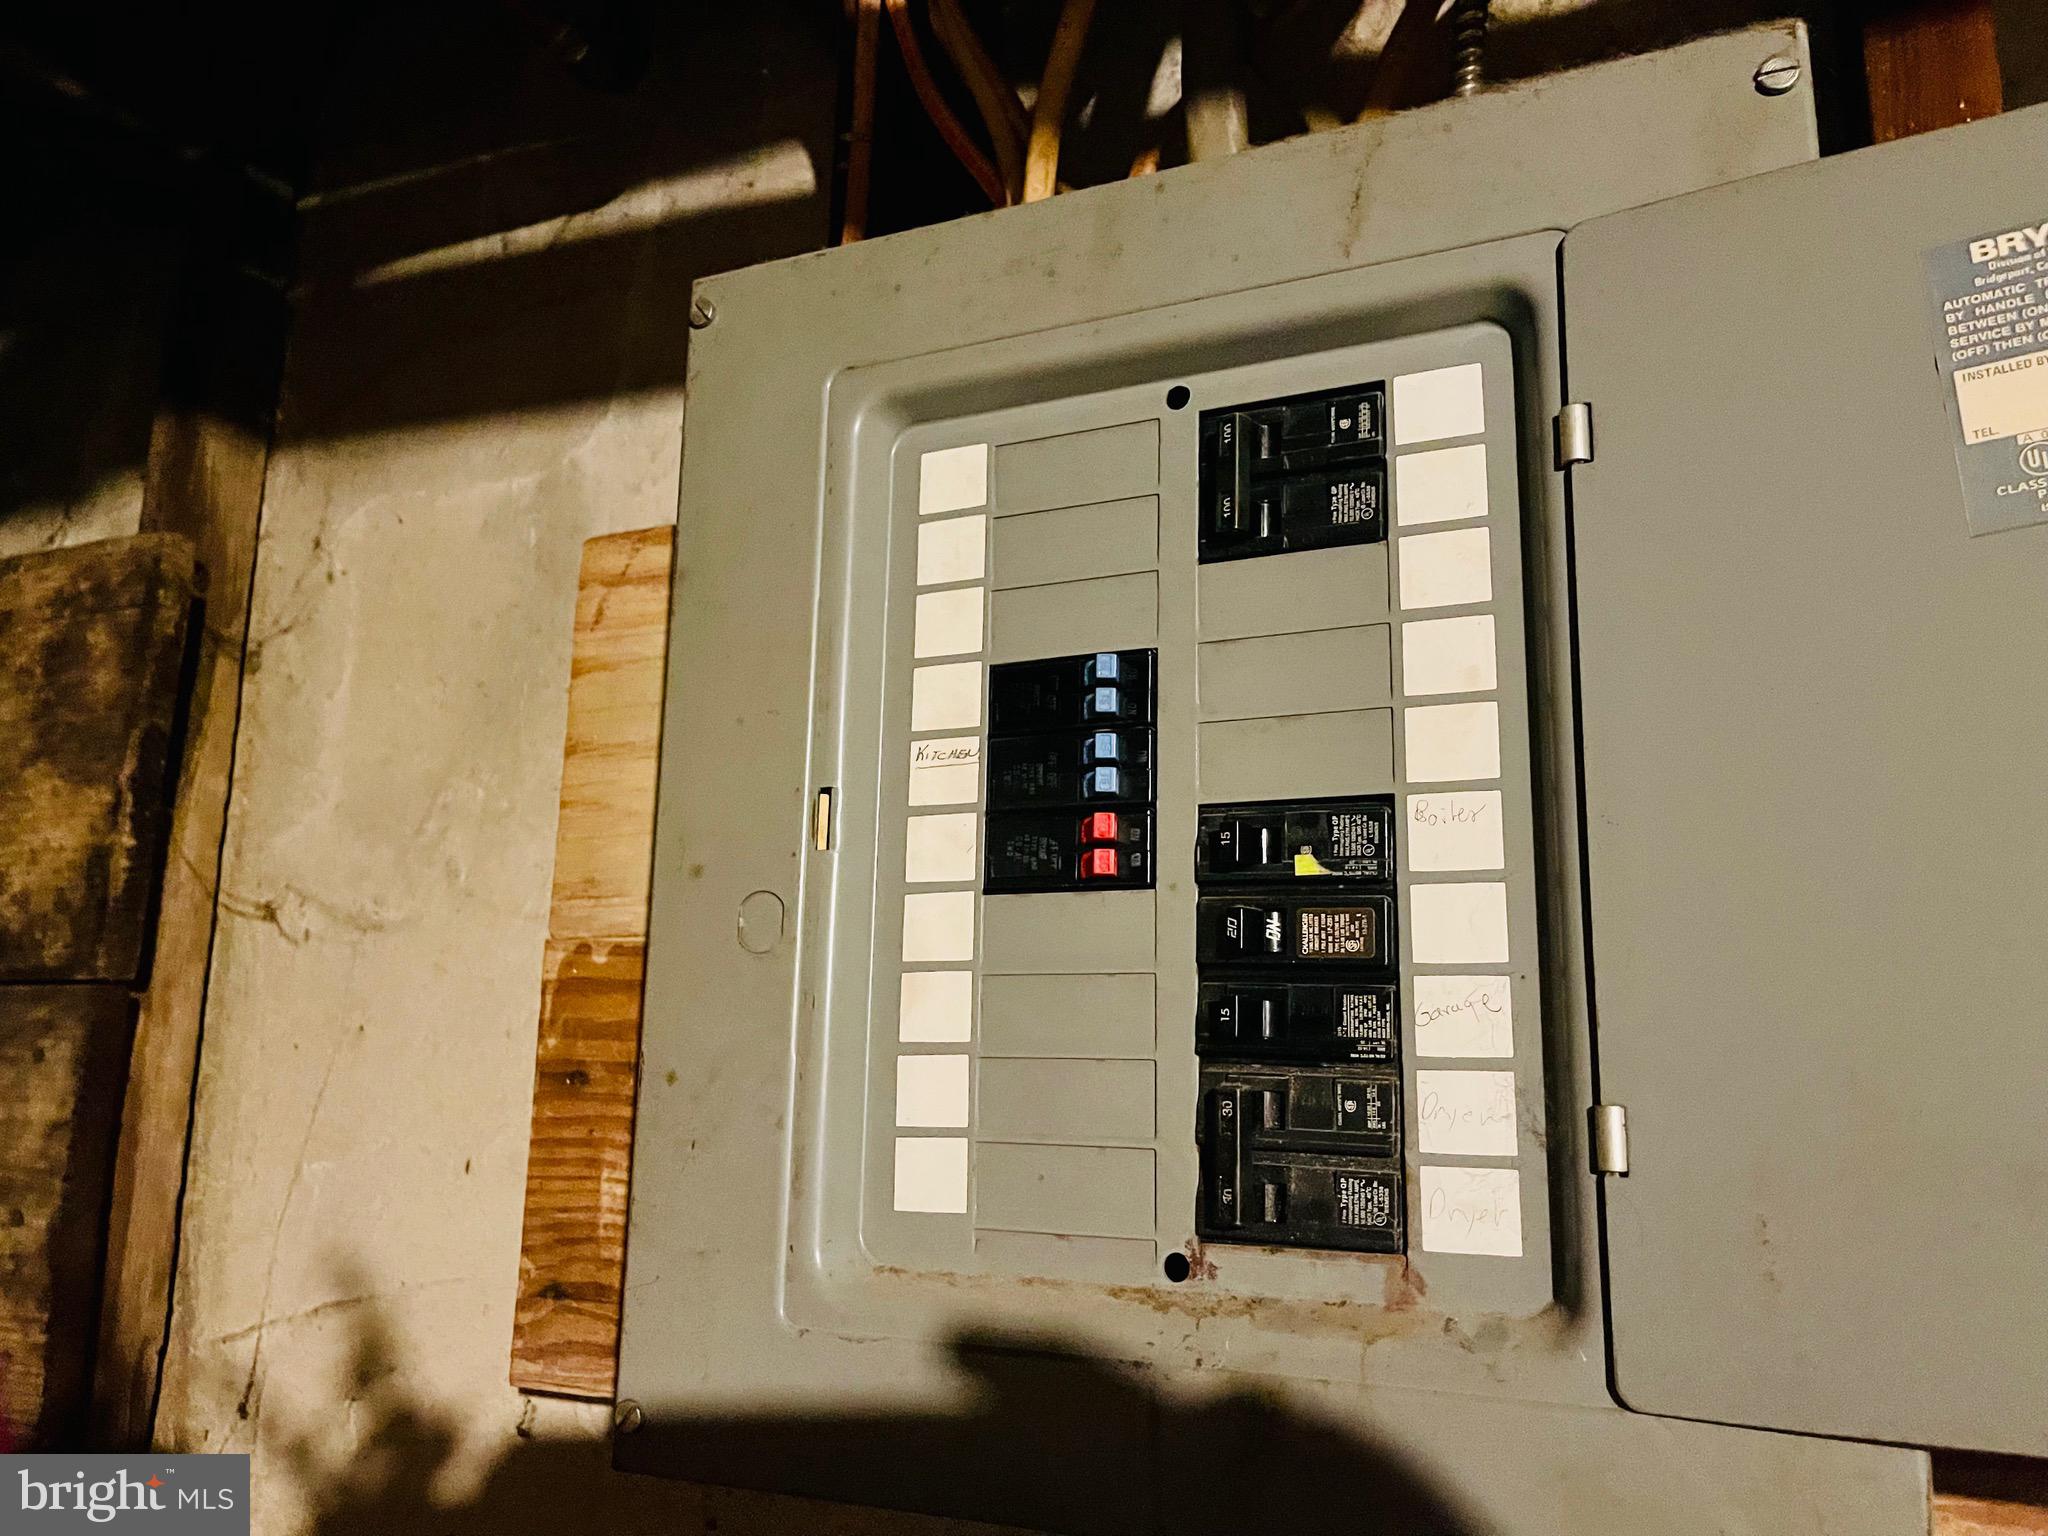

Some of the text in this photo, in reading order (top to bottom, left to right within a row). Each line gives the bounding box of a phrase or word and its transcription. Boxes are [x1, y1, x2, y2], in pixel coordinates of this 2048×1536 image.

[1988, 254, 2032, 270] Division
[1943, 283, 2026, 311] AUTOMATIC
[1945, 293, 2036, 324] BY HANDLE
[1947, 311, 2018, 337] BETWEEN
[1949, 326, 2012, 349] SERVICE
[2015, 320, 2035, 334] BY
[1952, 343, 1991, 362] (OFF)
[1993, 335, 2034, 353] THEN
[1961, 358, 2032, 383] INSTALLED
[1220, 831, 1231, 846] 15
[1331, 826, 1340, 842] Type
[1227, 917, 1238, 939] 20
[1265, 918, 1282, 941] ON
[1301, 912, 1309, 955] CHALLENGER
[1220, 1007, 1231, 1022] 15
[1222, 1100, 1233, 1117] 30
[1340, 1177, 1347, 1189] QP
[1340, 1190, 1348, 1208] Type
